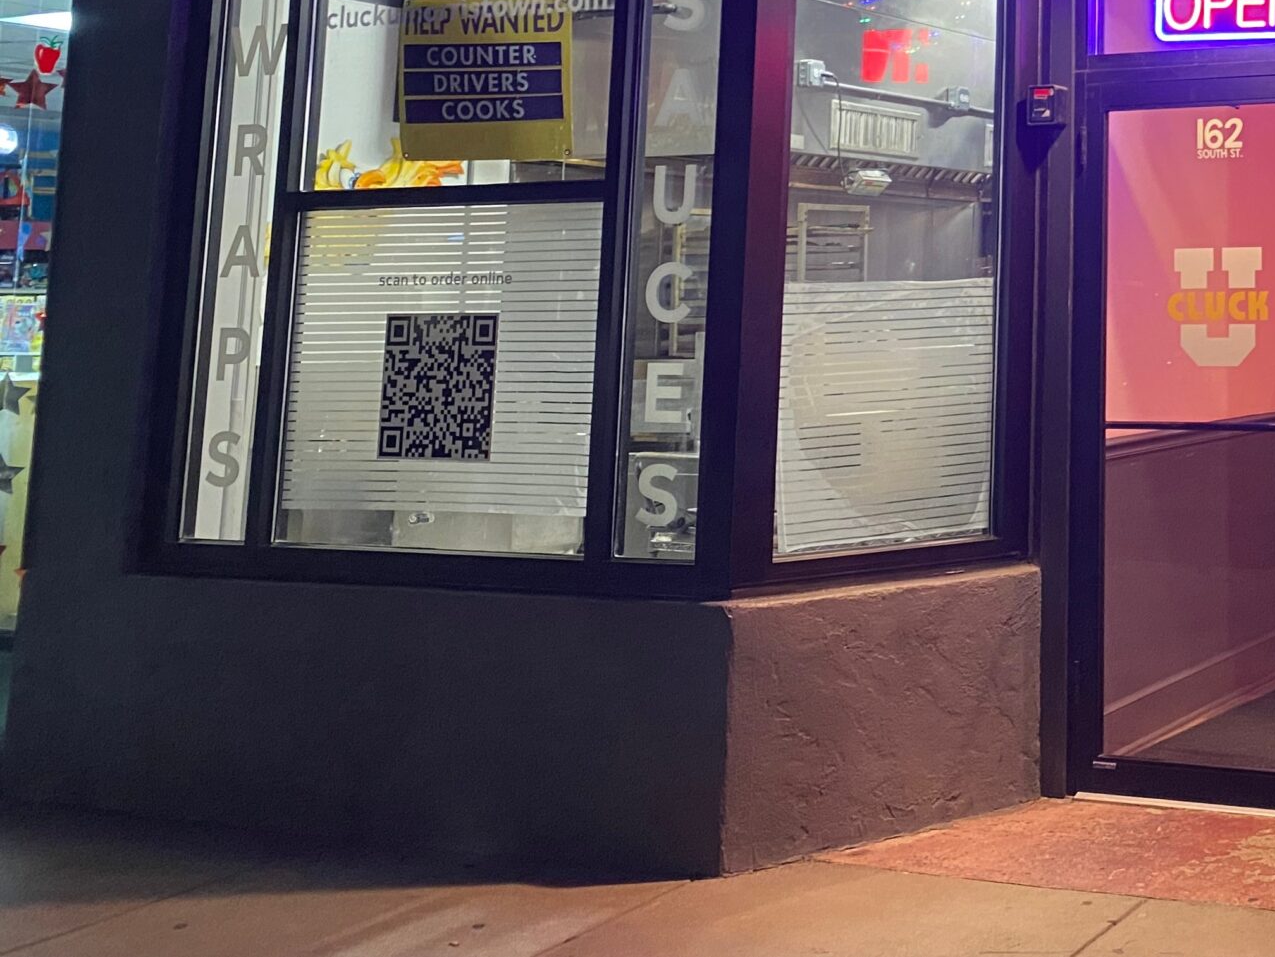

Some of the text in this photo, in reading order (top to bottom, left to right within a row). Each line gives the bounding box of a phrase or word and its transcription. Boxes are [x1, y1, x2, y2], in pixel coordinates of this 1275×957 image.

[459, 2, 565, 35] WANTED
[427, 44, 537, 66] COUNTER
[433, 72, 530, 94] DRIVERS
[441, 99, 526, 121] COOKS
[1196, 117, 1244, 150] 162
[1196, 148, 1245, 160] SOUTH ST.
[205, 23, 289, 488] WRAPS
[378, 271, 513, 287] scan to order online
[1166, 289, 1270, 323] CLUCK
[1173, 246, 1263, 368] U
